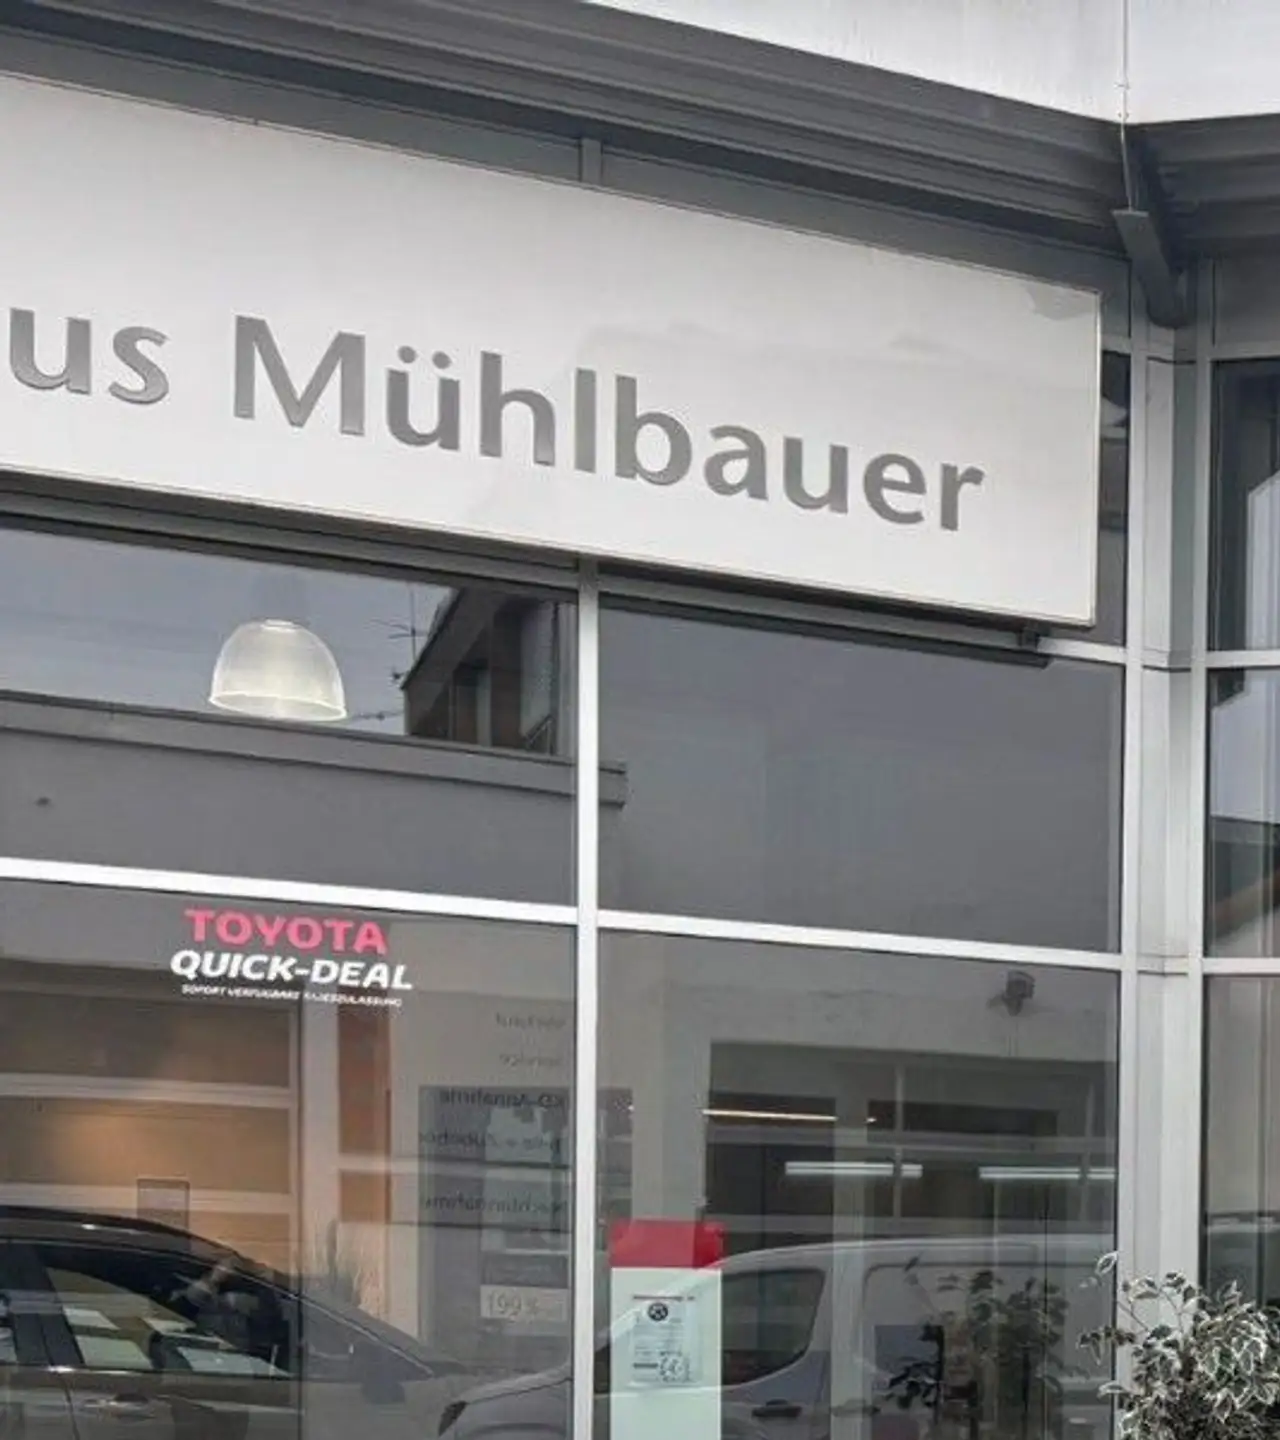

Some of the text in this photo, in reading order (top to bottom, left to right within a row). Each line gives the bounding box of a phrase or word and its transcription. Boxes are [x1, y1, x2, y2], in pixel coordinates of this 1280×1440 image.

[231, 314, 985, 531] Mühlbauer
[184, 907, 388, 955] TOYOTA
[169, 949, 415, 990] QUICK-DEAL
